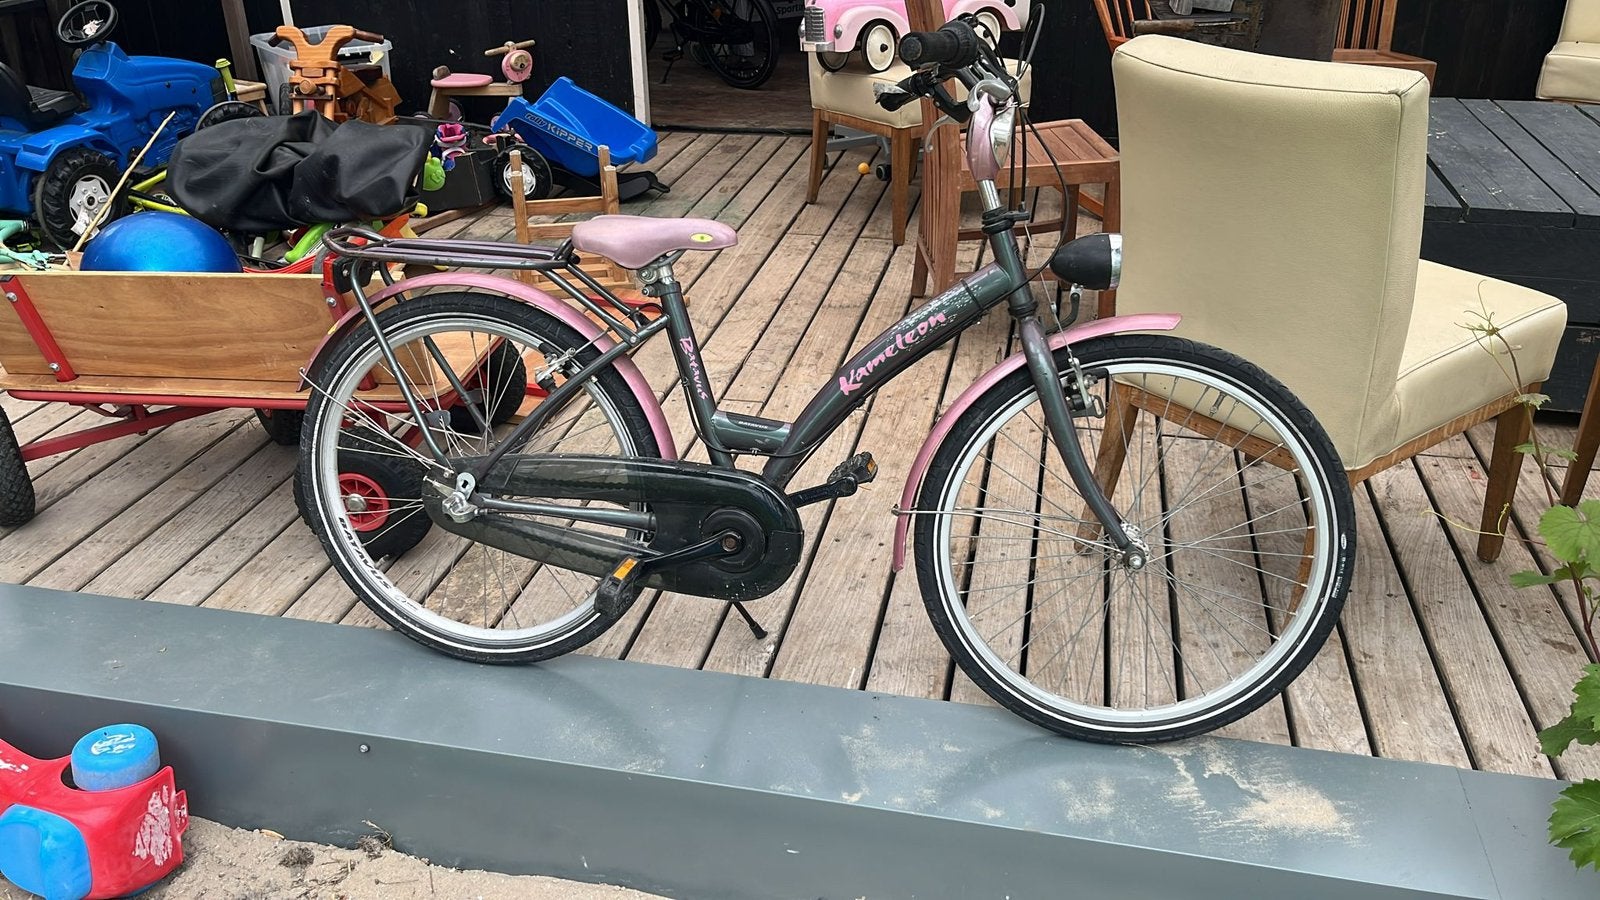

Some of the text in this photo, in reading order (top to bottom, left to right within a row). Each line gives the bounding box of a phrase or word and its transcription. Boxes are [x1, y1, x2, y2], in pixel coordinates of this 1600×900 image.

[680, 336, 708, 399] Batavus
[839, 312, 946, 395] Kameleon
[338, 517, 392, 589] BATAVUS
